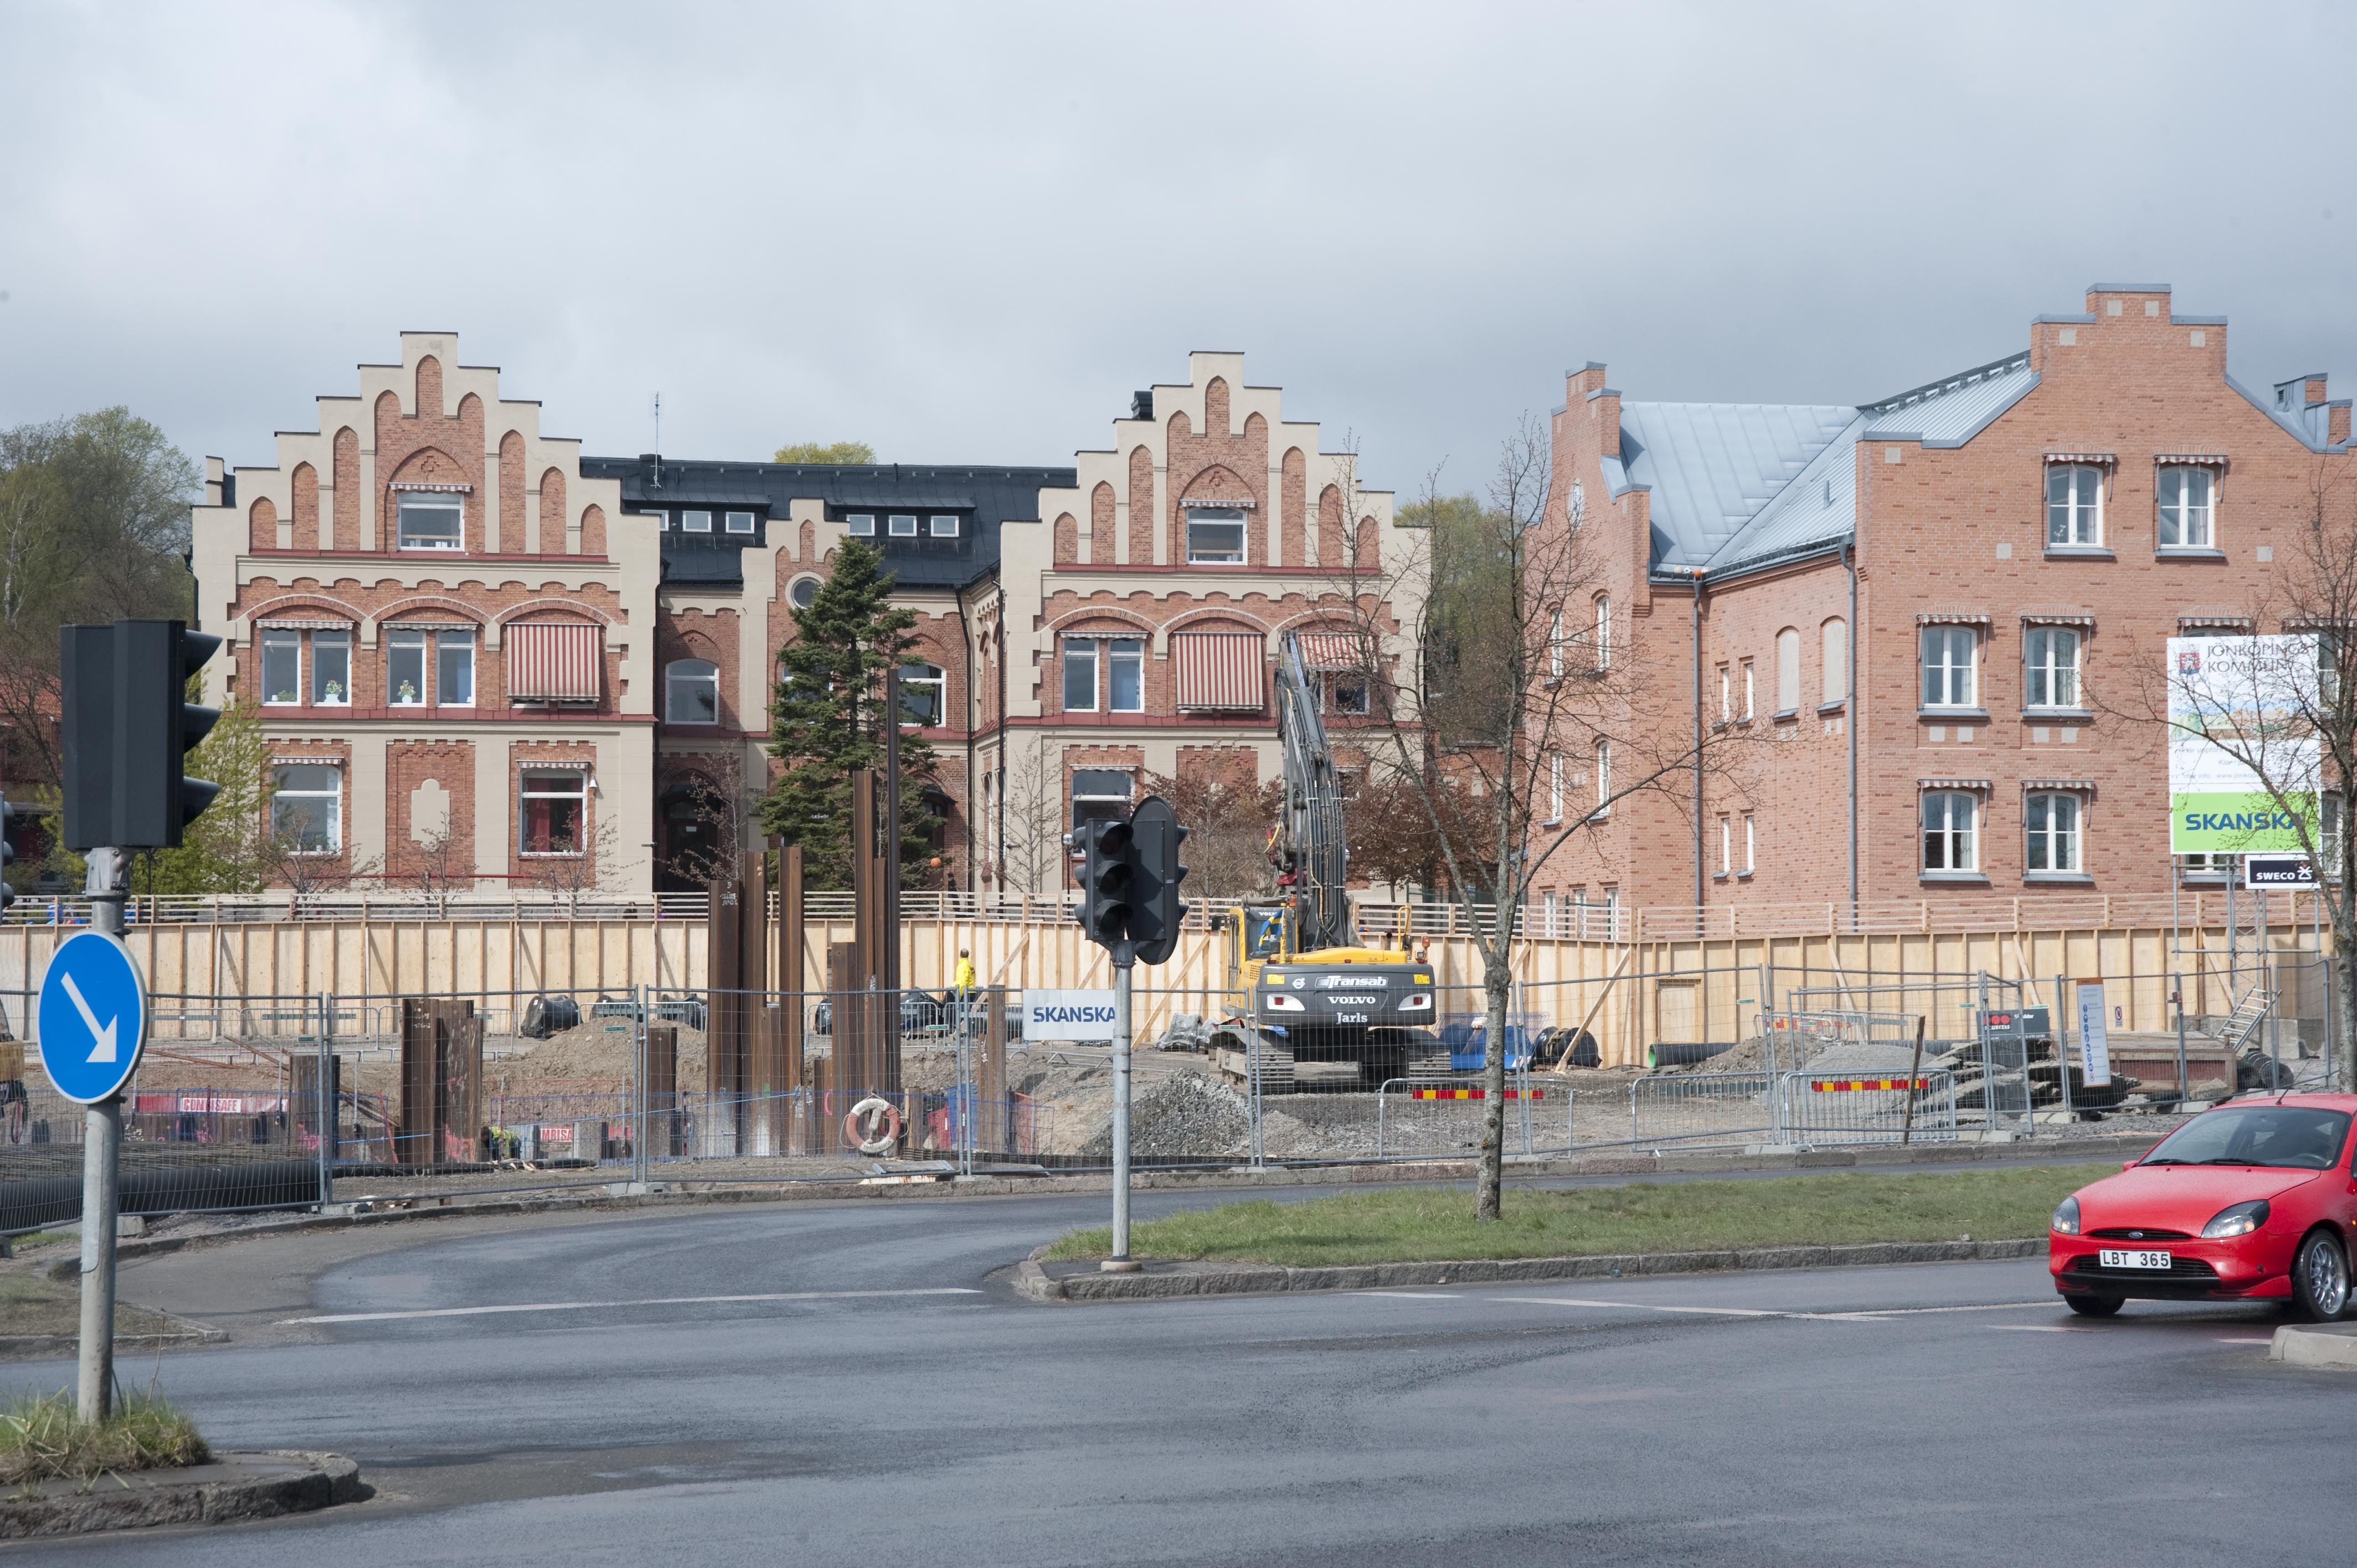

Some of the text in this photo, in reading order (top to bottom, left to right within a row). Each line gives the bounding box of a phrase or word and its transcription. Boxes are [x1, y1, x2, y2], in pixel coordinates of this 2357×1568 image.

[2256, 872, 2296, 880] SWECO
[1327, 975, 1387, 989] Transab
[1327, 996, 1376, 1004] VOLVO
[1033, 1007, 1115, 1022] SKANSKA
[1336, 1012, 1368, 1024] Jarls
[2103, 1251, 2169, 1267] LBT 365
